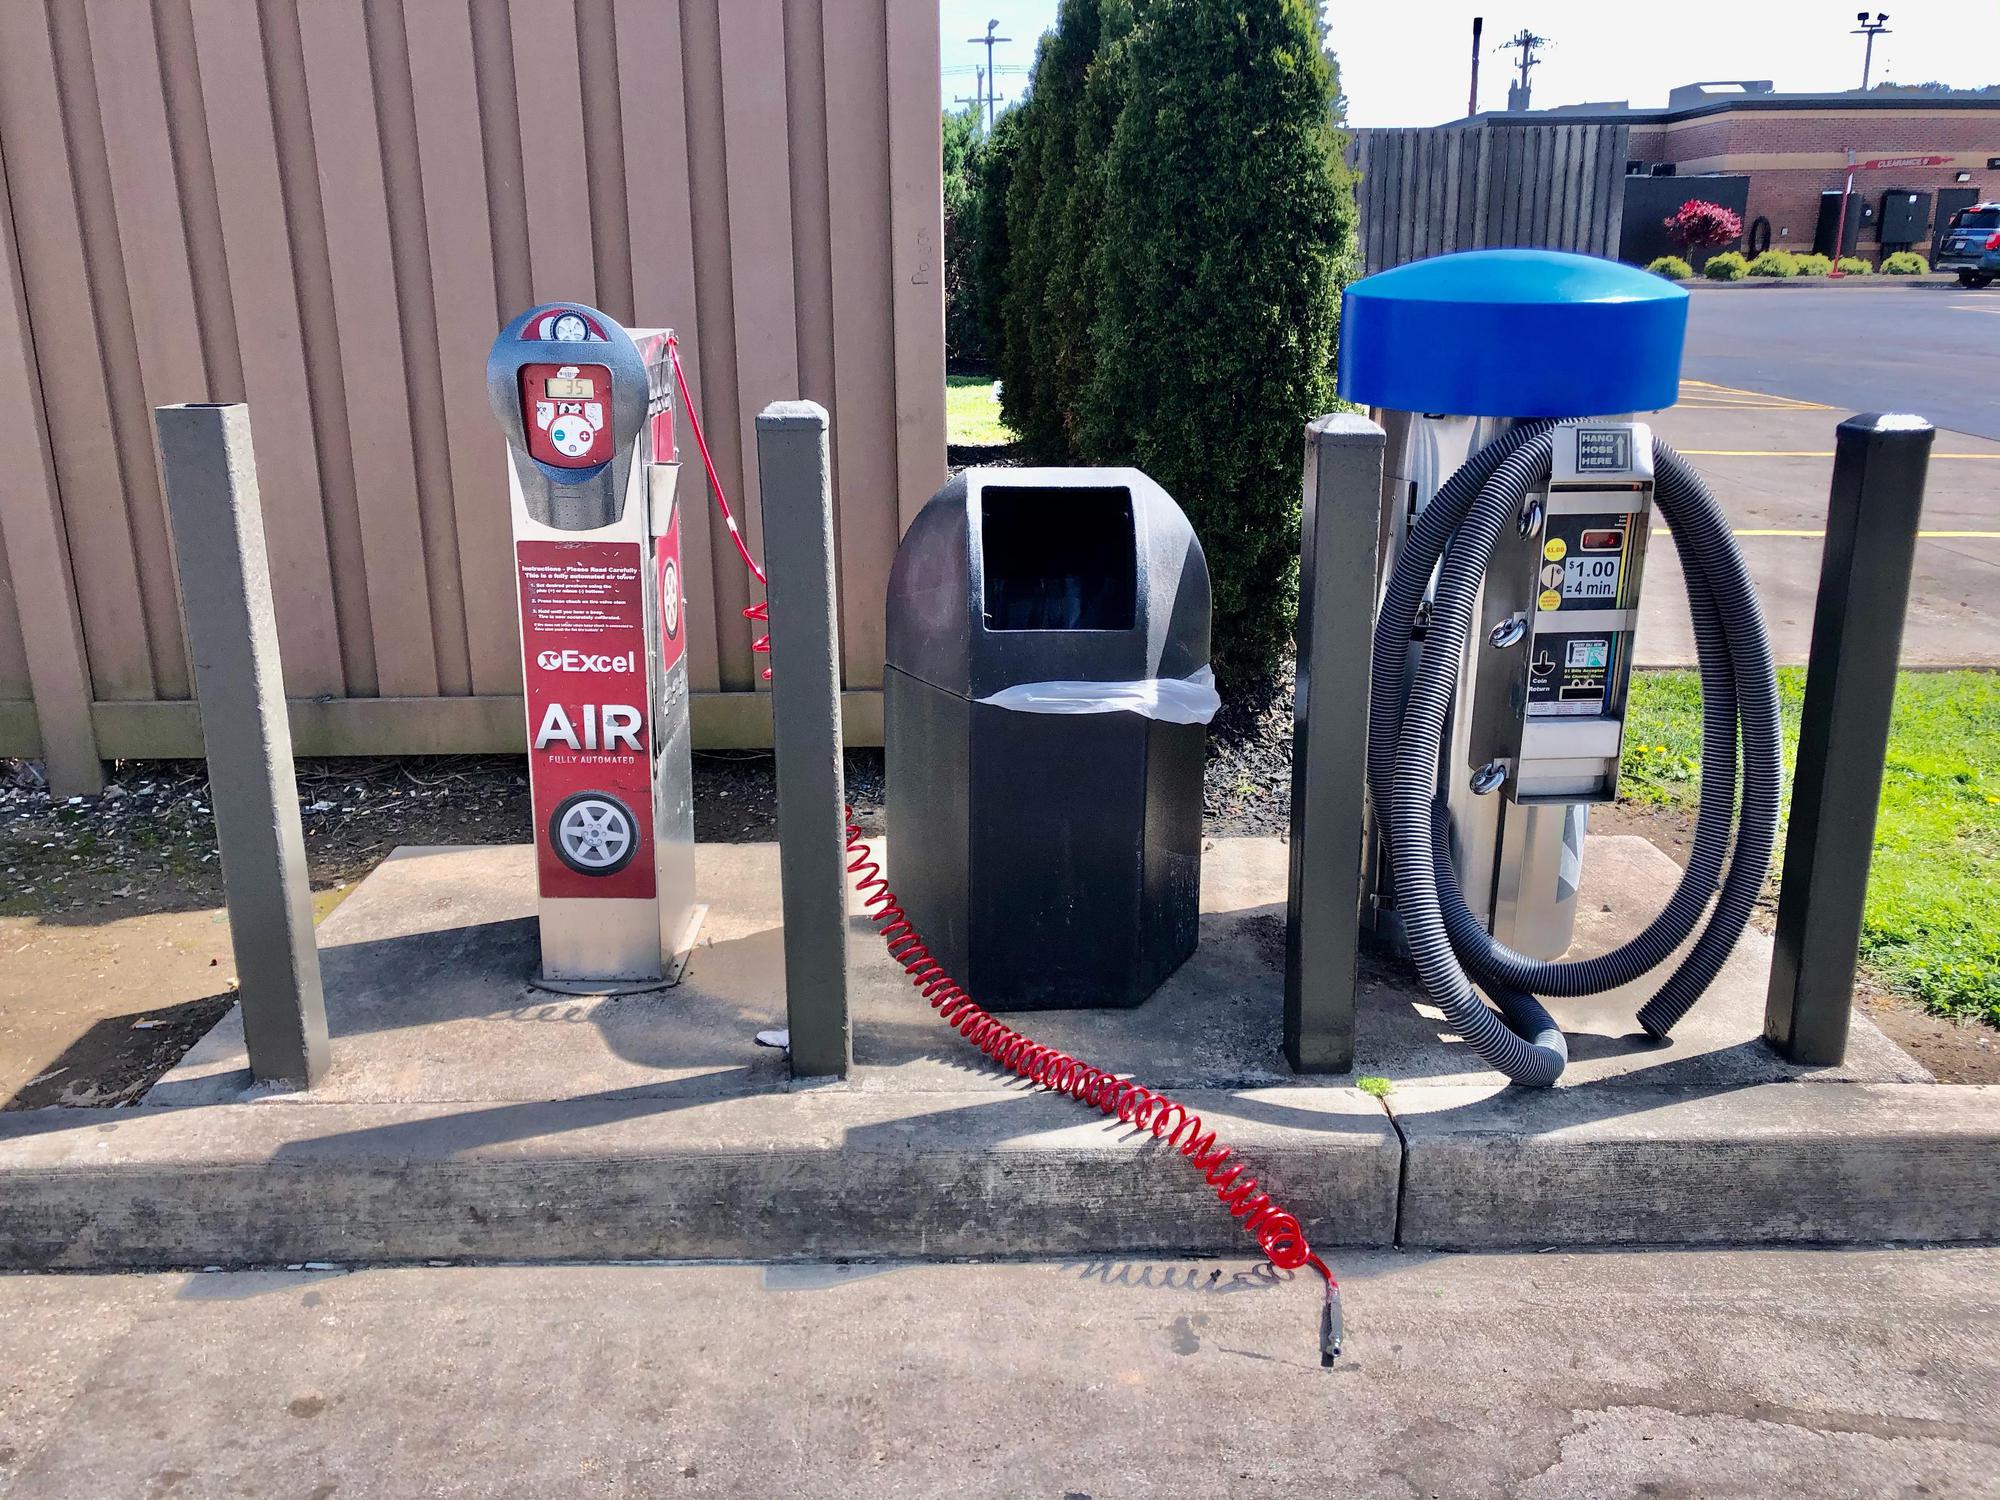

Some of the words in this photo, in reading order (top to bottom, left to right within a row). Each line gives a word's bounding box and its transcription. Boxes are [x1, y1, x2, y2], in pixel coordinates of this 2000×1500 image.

[1878, 159, 1922, 168] CLEARANCE
[566, 379, 584, 395] 35
[1582, 434, 1614, 443] HANG
[1582, 446, 1614, 454] HOSE
[1581, 457, 1613, 465] HERE
[608, 567, 638, 575] Carefully
[1569, 561, 1615, 578] $1.00
[553, 572, 569, 580] fully
[1574, 580, 1583, 596] 4
[1586, 580, 1614, 595] min.
[562, 649, 635, 673] Excel
[534, 703, 644, 751] AIR
[548, 755, 577, 764] FULLY
[580, 755, 635, 765] AUTOMATED
